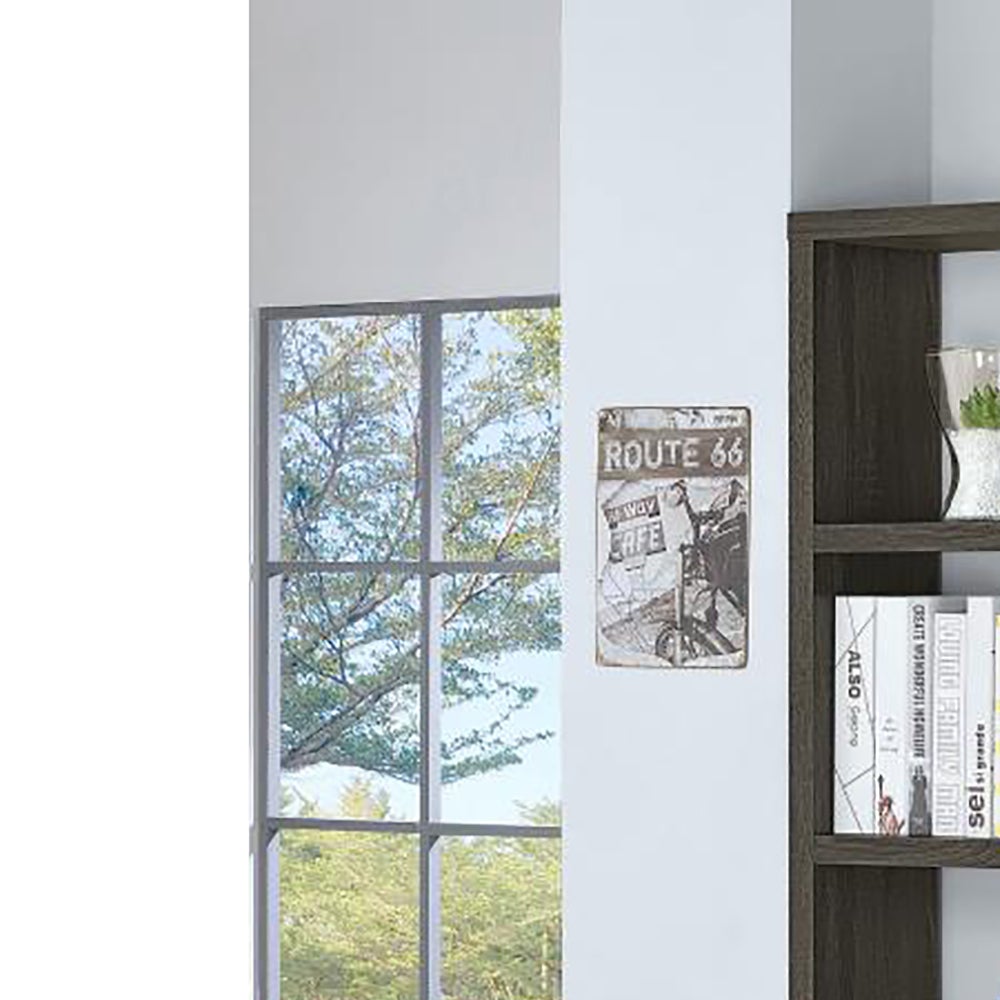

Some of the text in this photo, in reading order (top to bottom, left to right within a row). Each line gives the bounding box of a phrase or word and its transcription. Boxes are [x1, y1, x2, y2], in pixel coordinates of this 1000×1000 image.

[604, 436, 744, 472] ROUTE 66
[848, 650, 861, 699] ALSO
